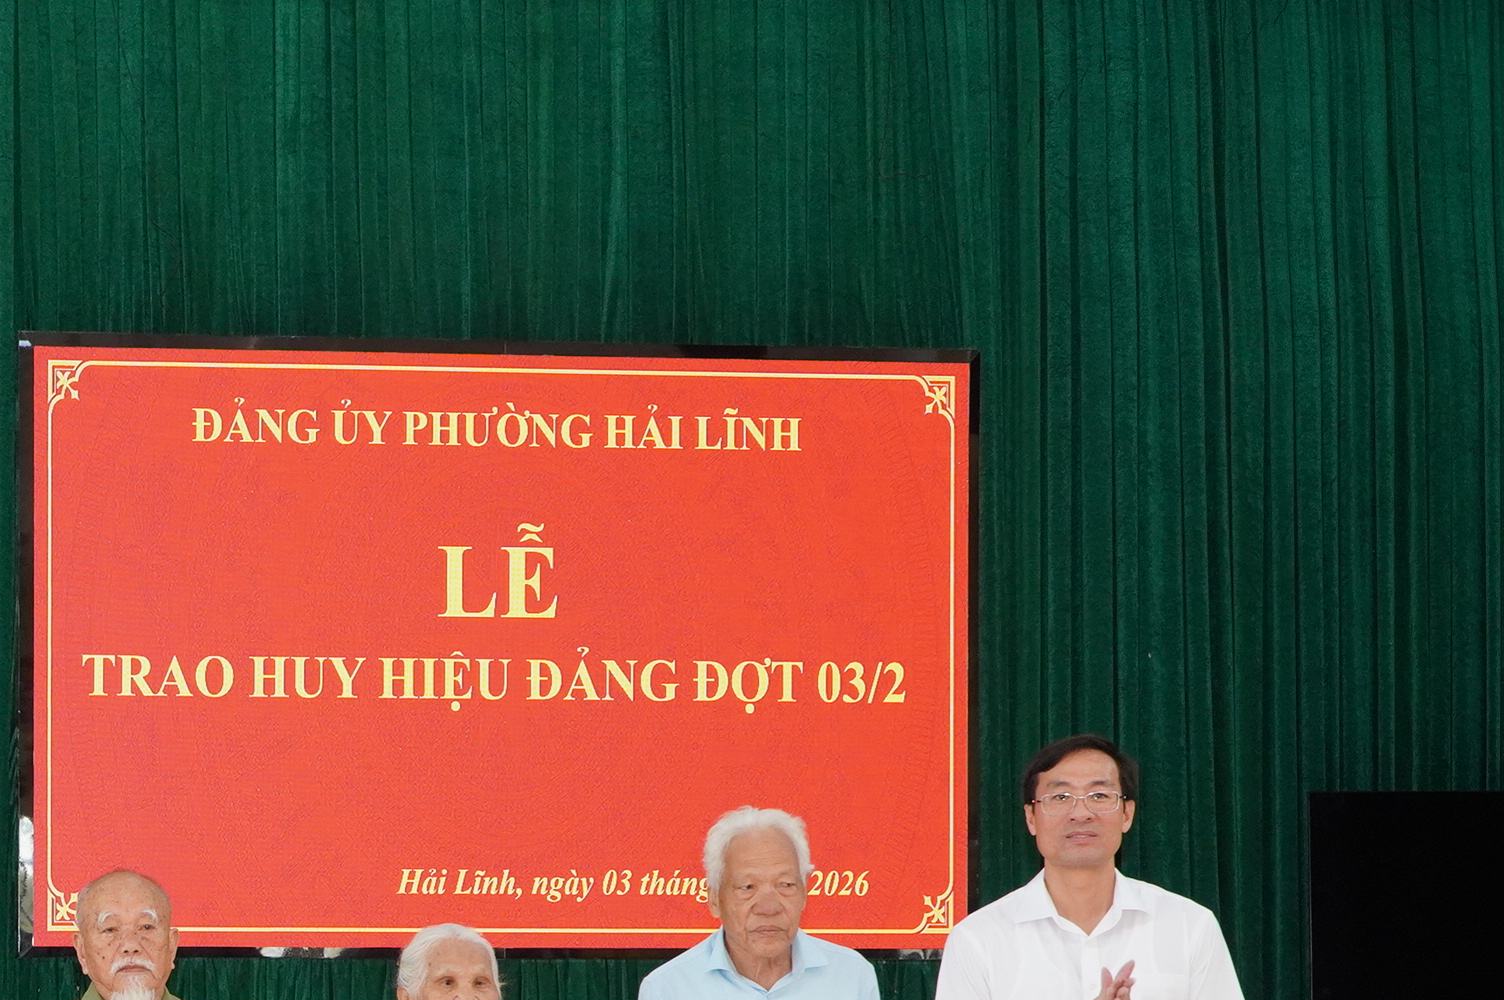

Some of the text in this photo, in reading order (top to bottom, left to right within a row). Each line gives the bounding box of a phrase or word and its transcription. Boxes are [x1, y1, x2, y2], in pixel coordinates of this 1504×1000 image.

[192, 397, 802, 451] ĐẢNG ỦY PHƯỜNG HẢI LĨNH
[438, 522, 558, 619] LỄ
[82, 646, 907, 714] TRAO HUY HIỆU ĐẢNG ĐỢT 03/2
[396, 868, 708, 903] Hải Lĩnh, ngày 03 tháng
[807, 870, 870, 897] 2026
